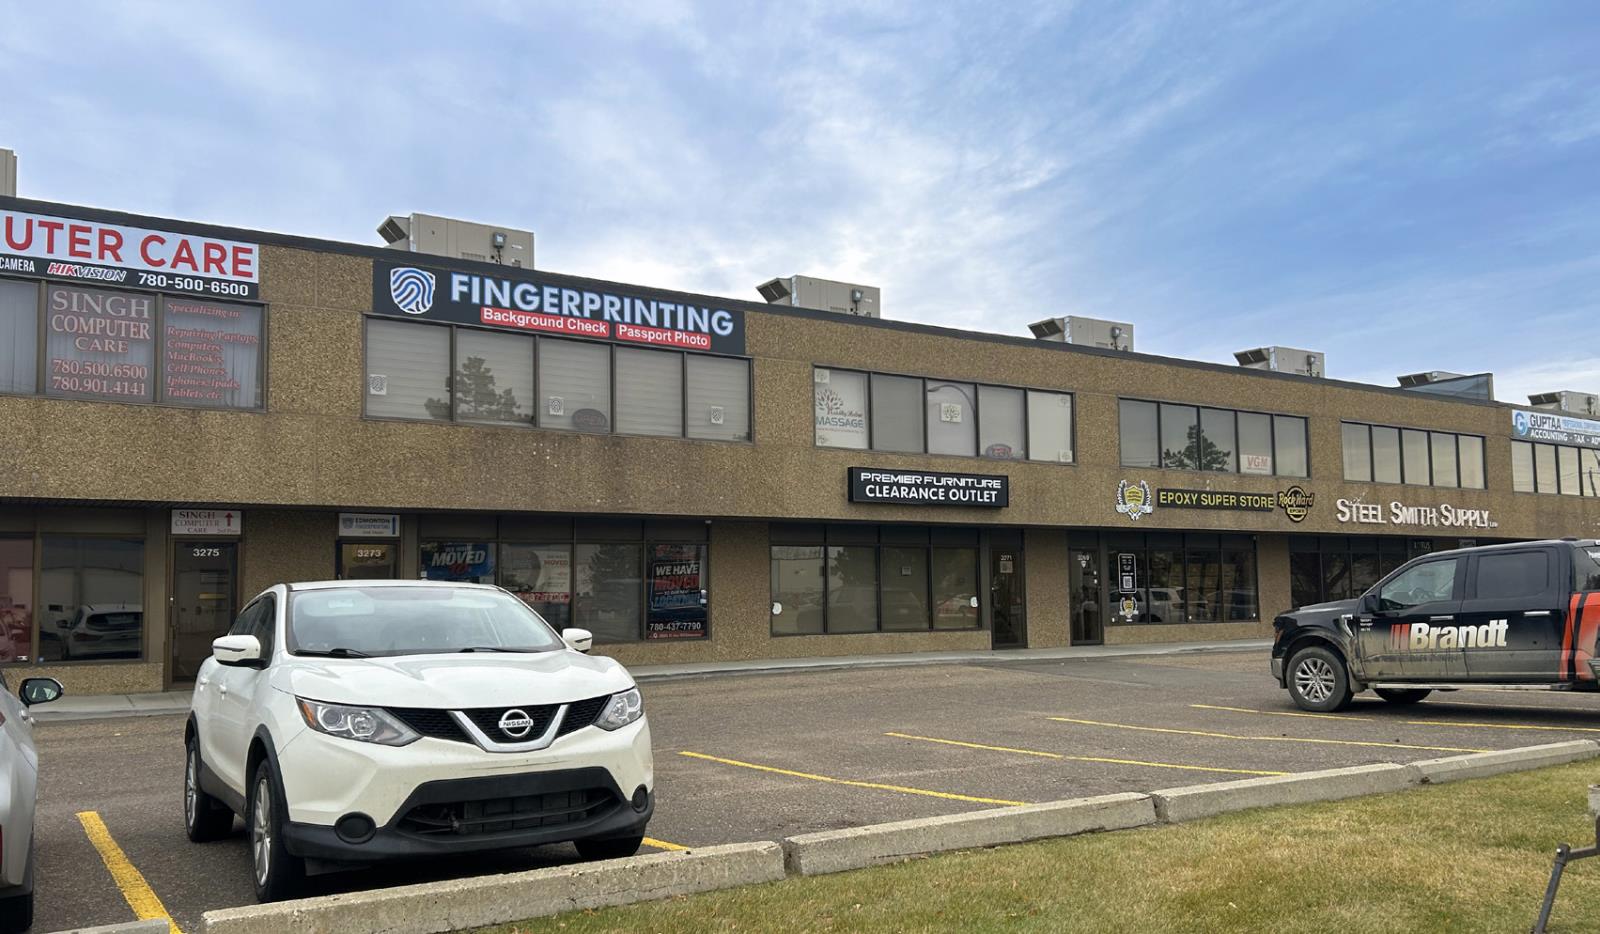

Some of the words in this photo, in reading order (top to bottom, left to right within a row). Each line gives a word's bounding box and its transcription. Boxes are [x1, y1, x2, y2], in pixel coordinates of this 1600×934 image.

[5, 216, 124, 262] UTER
[140, 234, 254, 278] CARE
[0, 257, 35, 272] CAMERA
[47, 262, 127, 282] HIKVISION
[138, 272, 249, 296] 780-500-6500
[52, 290, 151, 319] SINGH
[451, 272, 734, 336] FINGERPRINTING
[52, 314, 151, 340] COMPUTER
[483, 308, 563, 329] Background
[567, 317, 607, 334] Check
[618, 325, 671, 342] Passport
[674, 330, 708, 346] Photo
[75, 337, 129, 353] CARE
[52, 359, 148, 379] 780.500.6500
[52, 376, 145, 395] 780.901.4141
[816, 416, 864, 429] MASSAGE
[1530, 414, 1561, 430] GUPTAA
[1530, 429, 1568, 441] ACCOUNTING
[1574, 434, 1585, 444] TAX
[1247, 455, 1268, 468] VGM
[860, 472, 922, 485] PREMIER
[924, 475, 1001, 488] FURNITURE
[865, 484, 945, 500] CLEARANCE
[949, 487, 997, 502] OUTLET
[1160, 491, 1197, 505] EPOXY
[1201, 493, 1236, 507] SUPER
[1240, 494, 1275, 508] STORE
[174, 519, 220, 528] COMPUTER
[179, 511, 215, 520] SINGH
[192, 548, 220, 557] 3275
[357, 549, 381, 558] 3273
[432, 550, 486, 568] MOVED
[656, 566, 672, 576] WE
[673, 563, 699, 575] HAVE
[649, 622, 701, 632] 780-437-7790
[1410, 619, 1509, 650] Brandt
